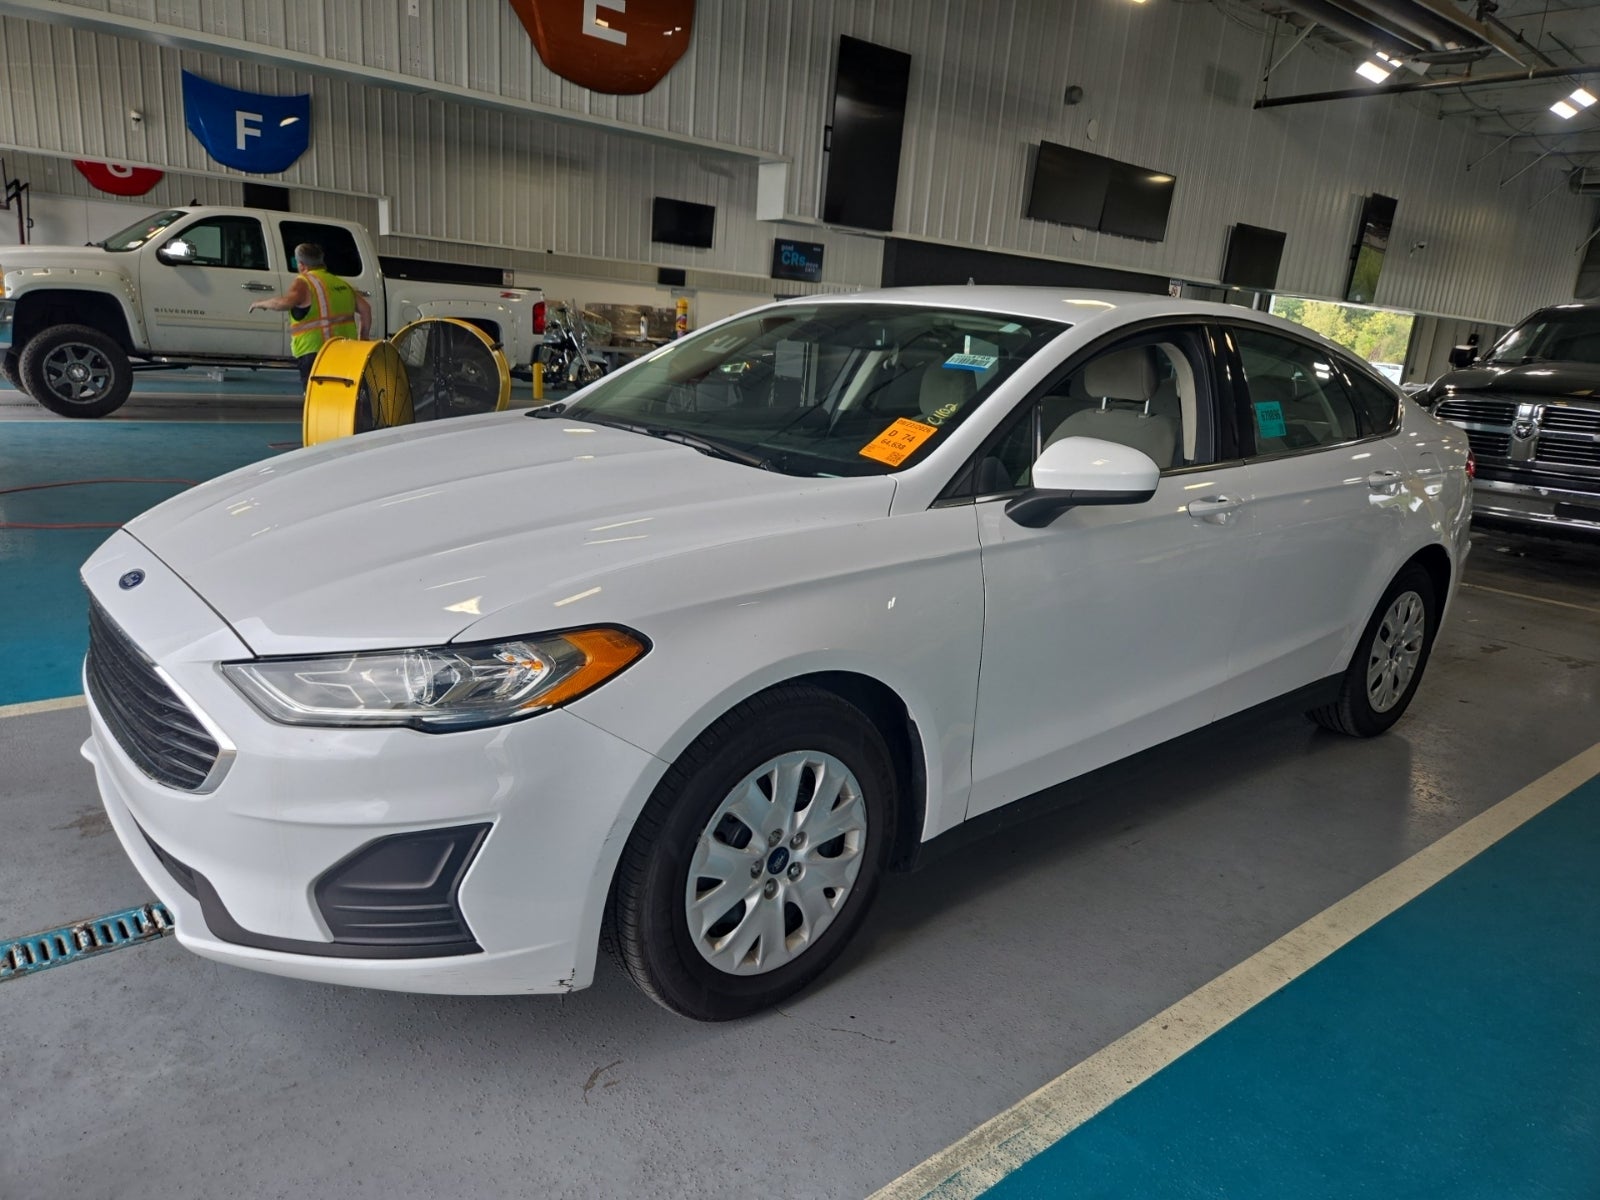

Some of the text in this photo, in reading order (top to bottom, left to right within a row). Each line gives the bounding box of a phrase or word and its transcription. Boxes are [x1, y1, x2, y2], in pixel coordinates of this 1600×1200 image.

[235, 110, 263, 151] F
[782, 251, 806, 266] CRs
[902, 433, 916, 443] 74
